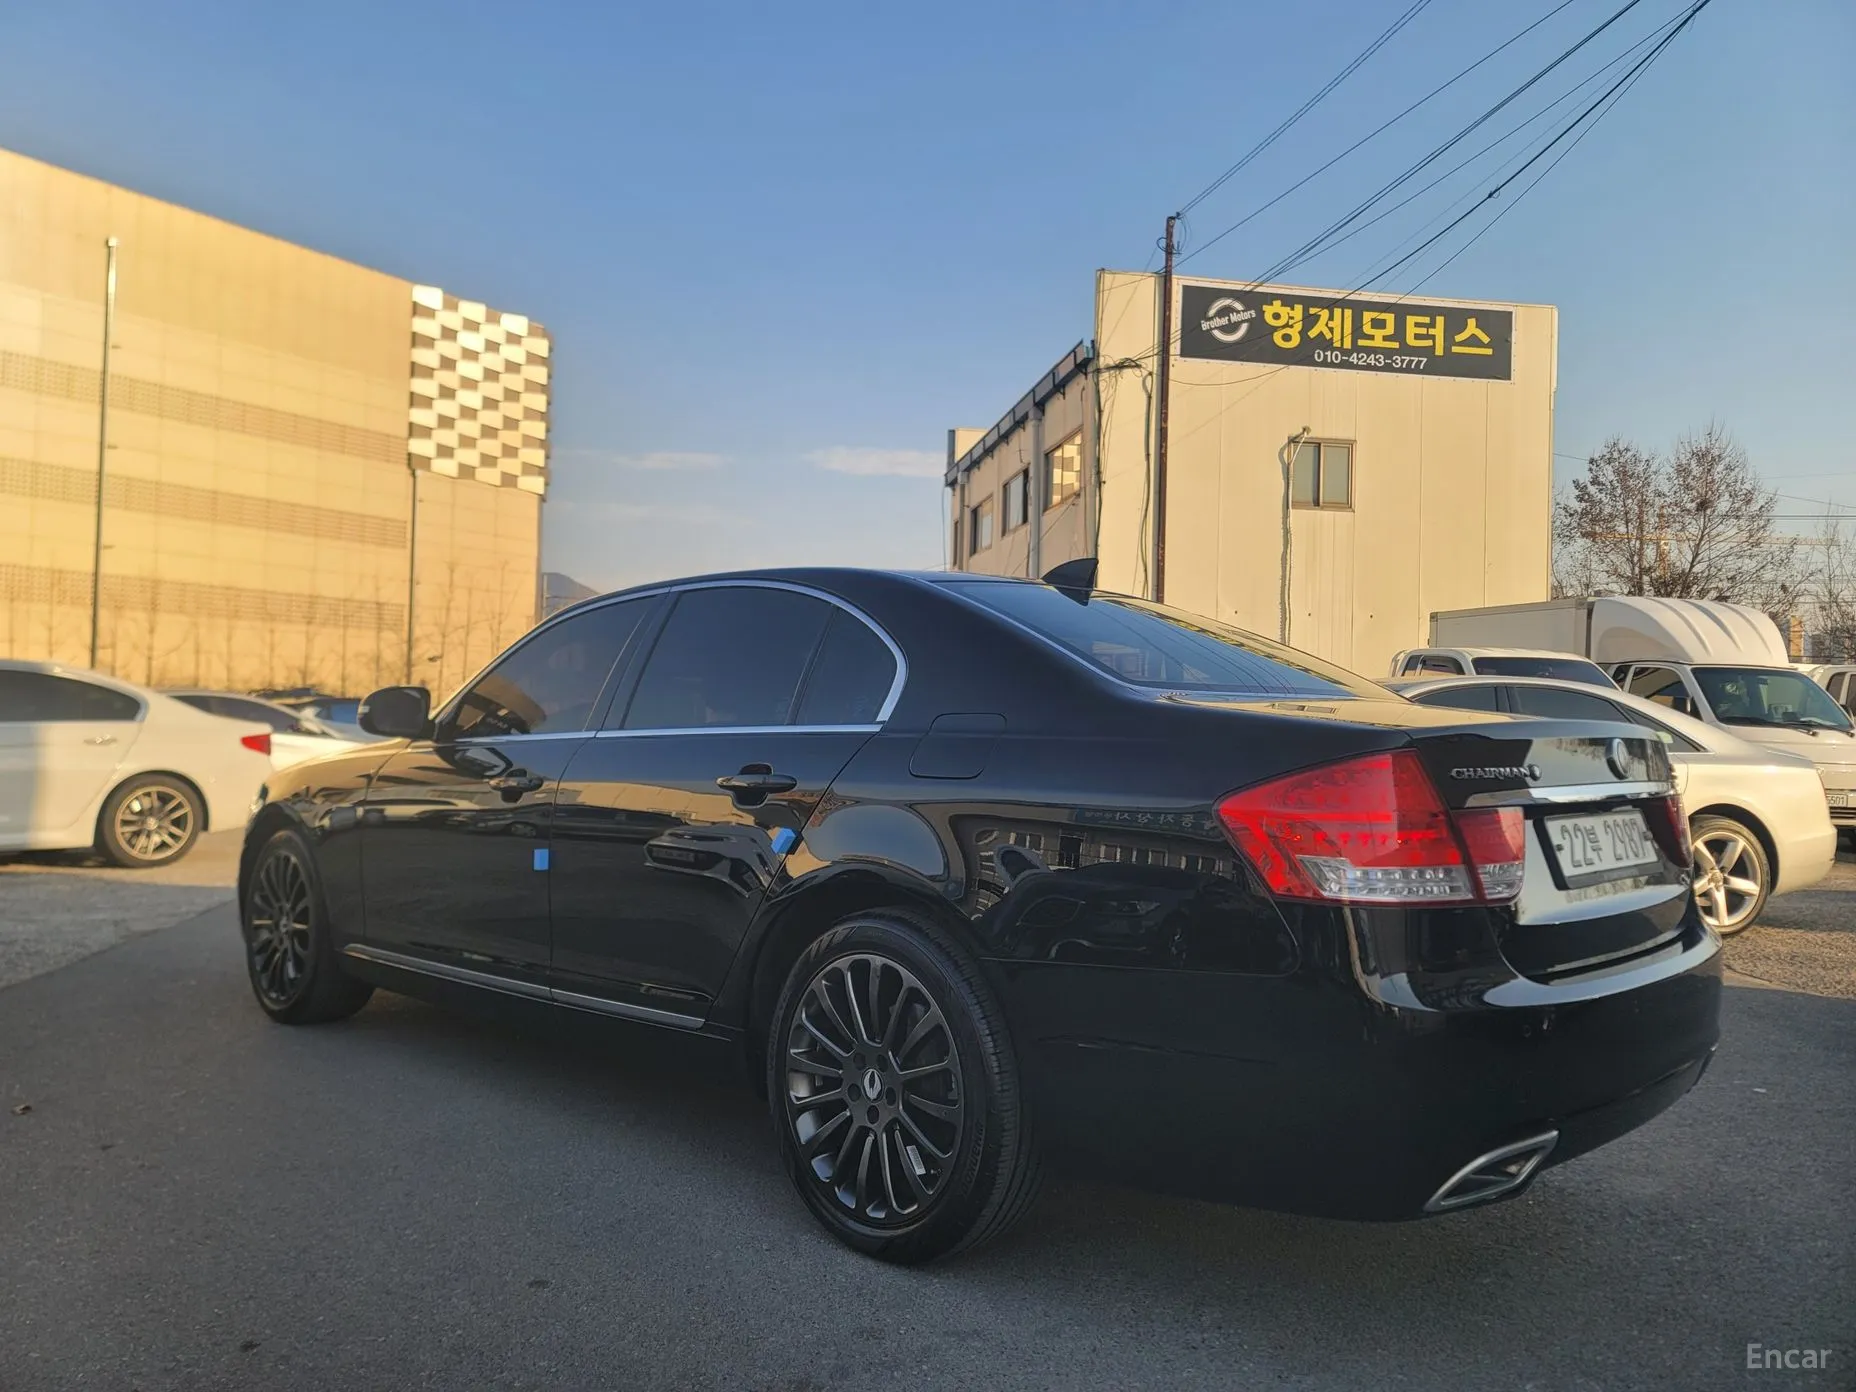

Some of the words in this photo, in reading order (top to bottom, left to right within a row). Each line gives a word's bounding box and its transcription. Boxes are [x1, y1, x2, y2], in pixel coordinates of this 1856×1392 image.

[1200, 316, 1229, 331] Brother
[1229, 309, 1257, 324] Motors
[1262, 299, 1493, 357] 형제모터스
[1314, 349, 1428, 370] 010-4243-3777
[1450, 766, 1530, 780] CHAIRMAN
[1603, 818, 1647, 861] 2987
